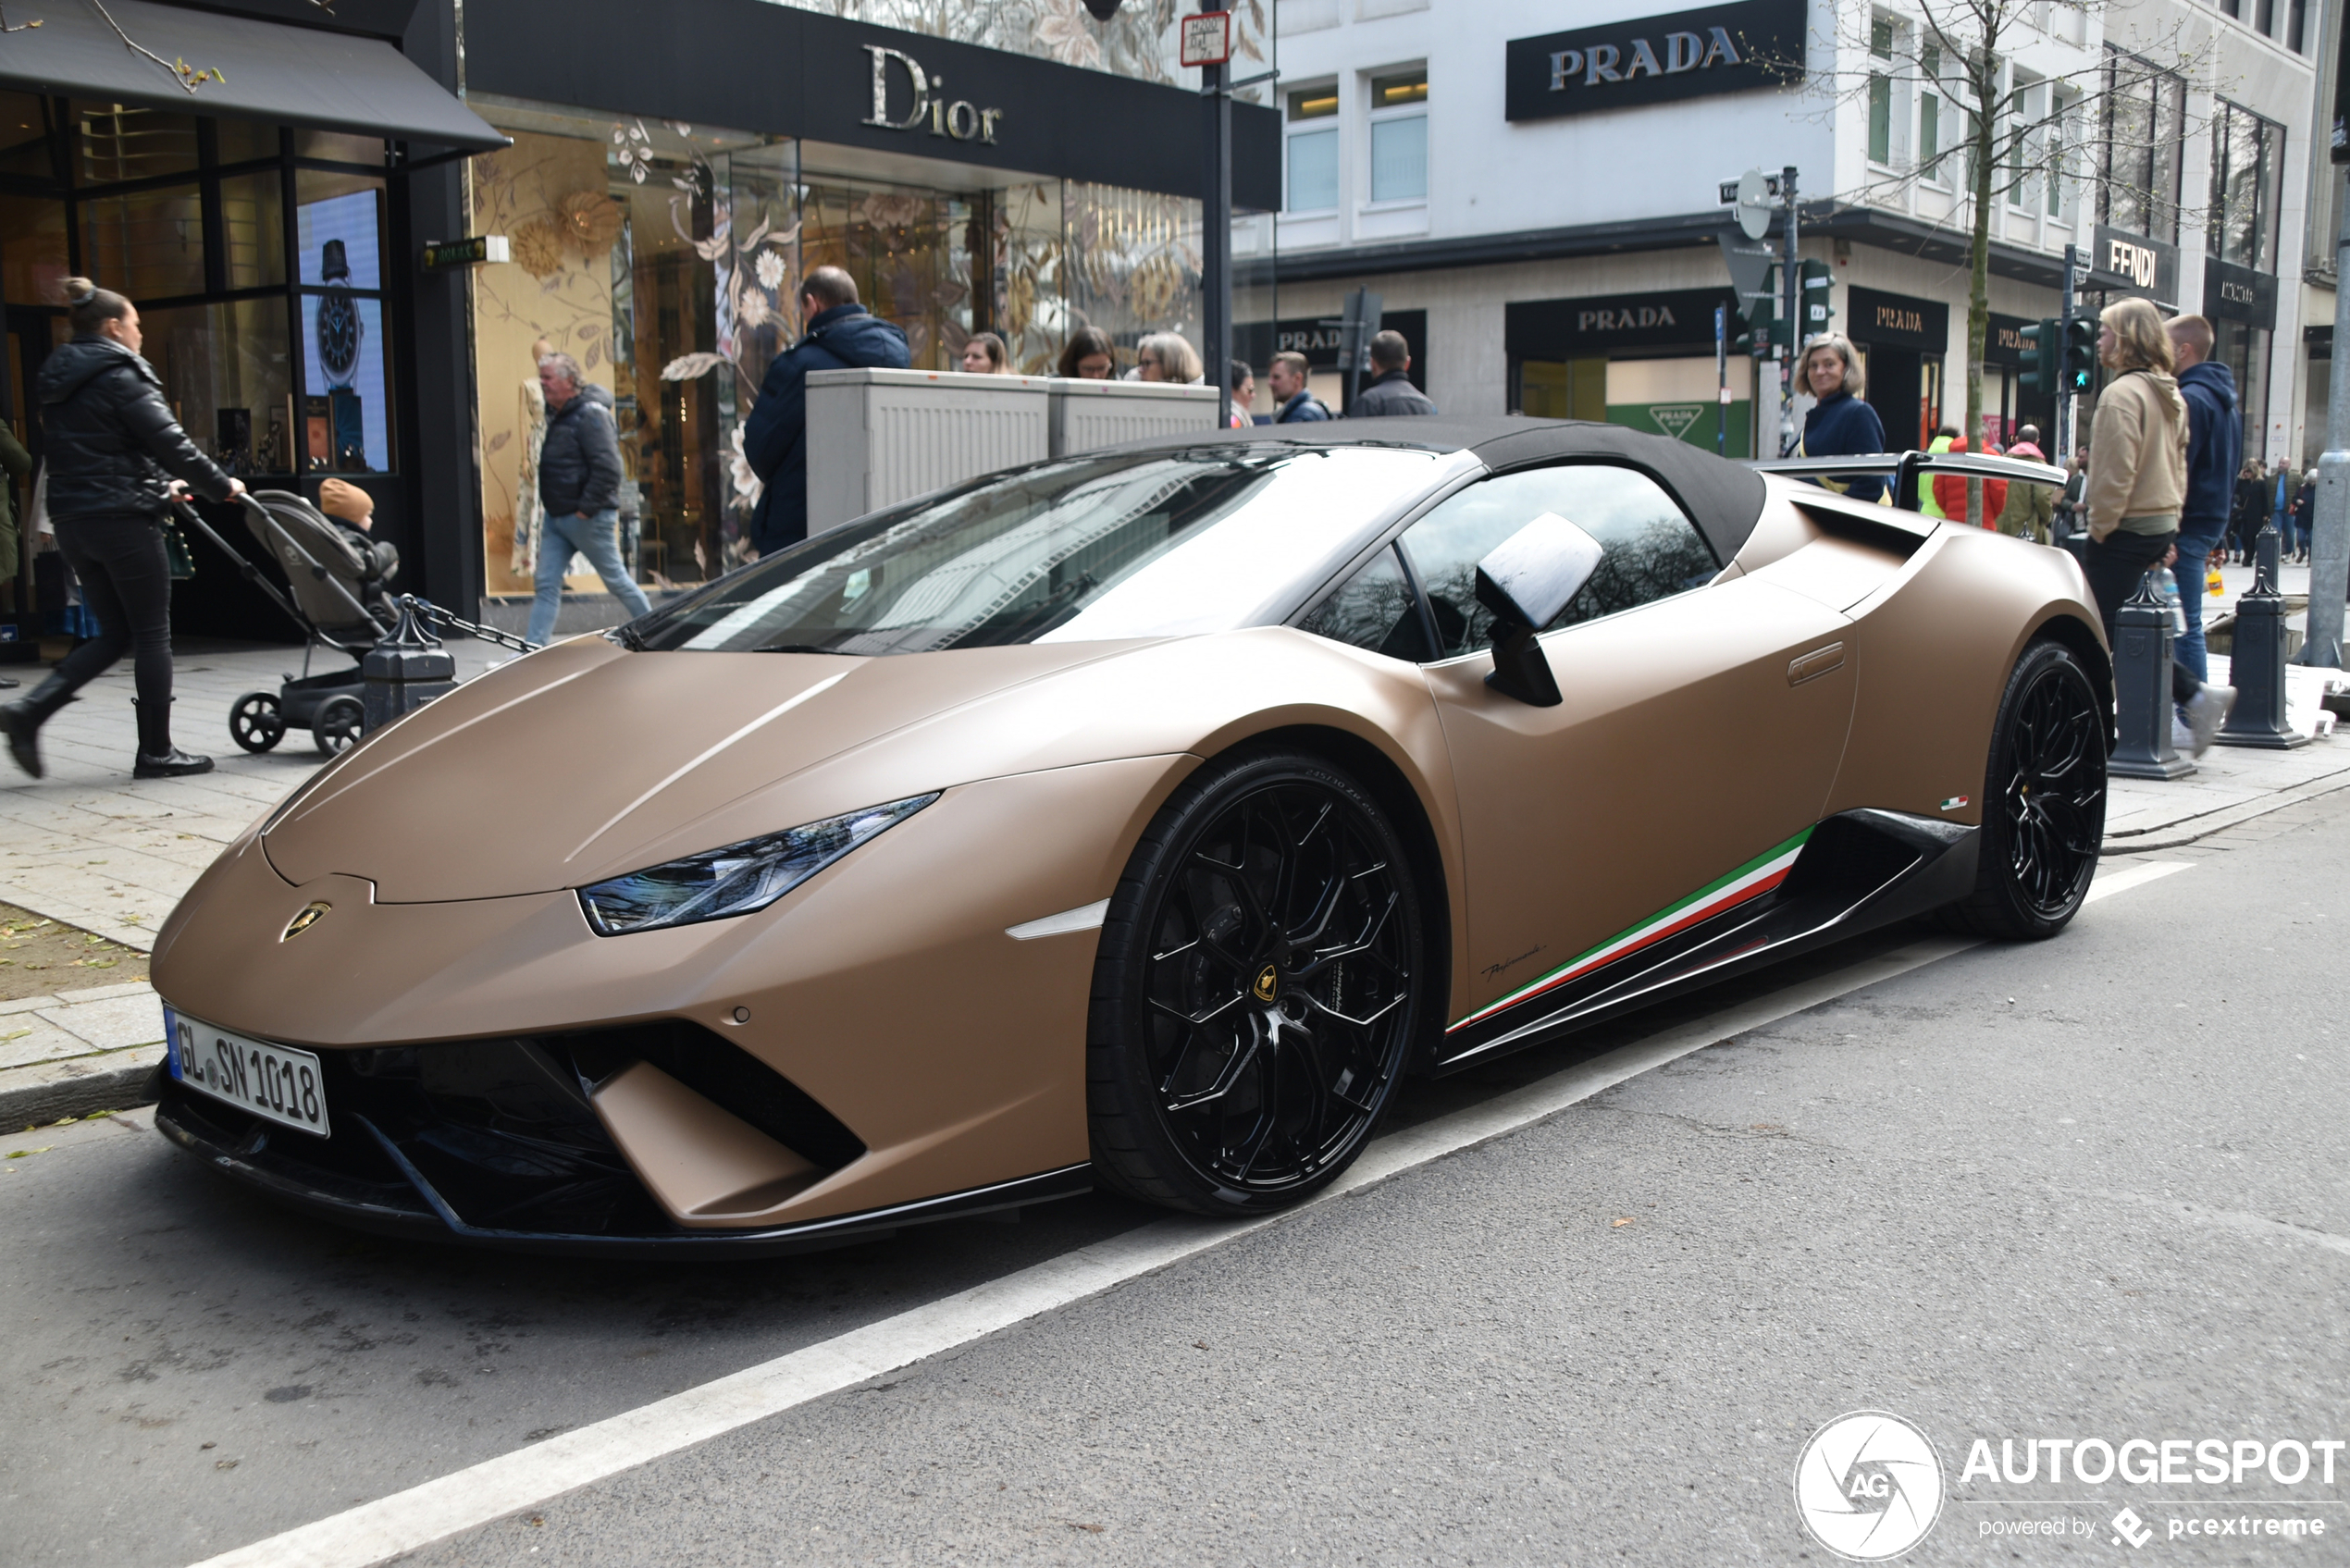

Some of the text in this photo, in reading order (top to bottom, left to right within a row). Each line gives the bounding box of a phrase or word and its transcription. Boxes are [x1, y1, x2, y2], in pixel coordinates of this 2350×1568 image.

[1549, 26, 1741, 91] PRADA
[860, 43, 1004, 145] Dior
[1577, 305, 1676, 332] PRADA
[1876, 305, 1923, 332] PRADA
[1278, 328, 1342, 352] PRAD
[1305, 768, 1345, 788] 245/30
[177, 1021, 205, 1082] GL
[250, 1050, 320, 1124] 1018
